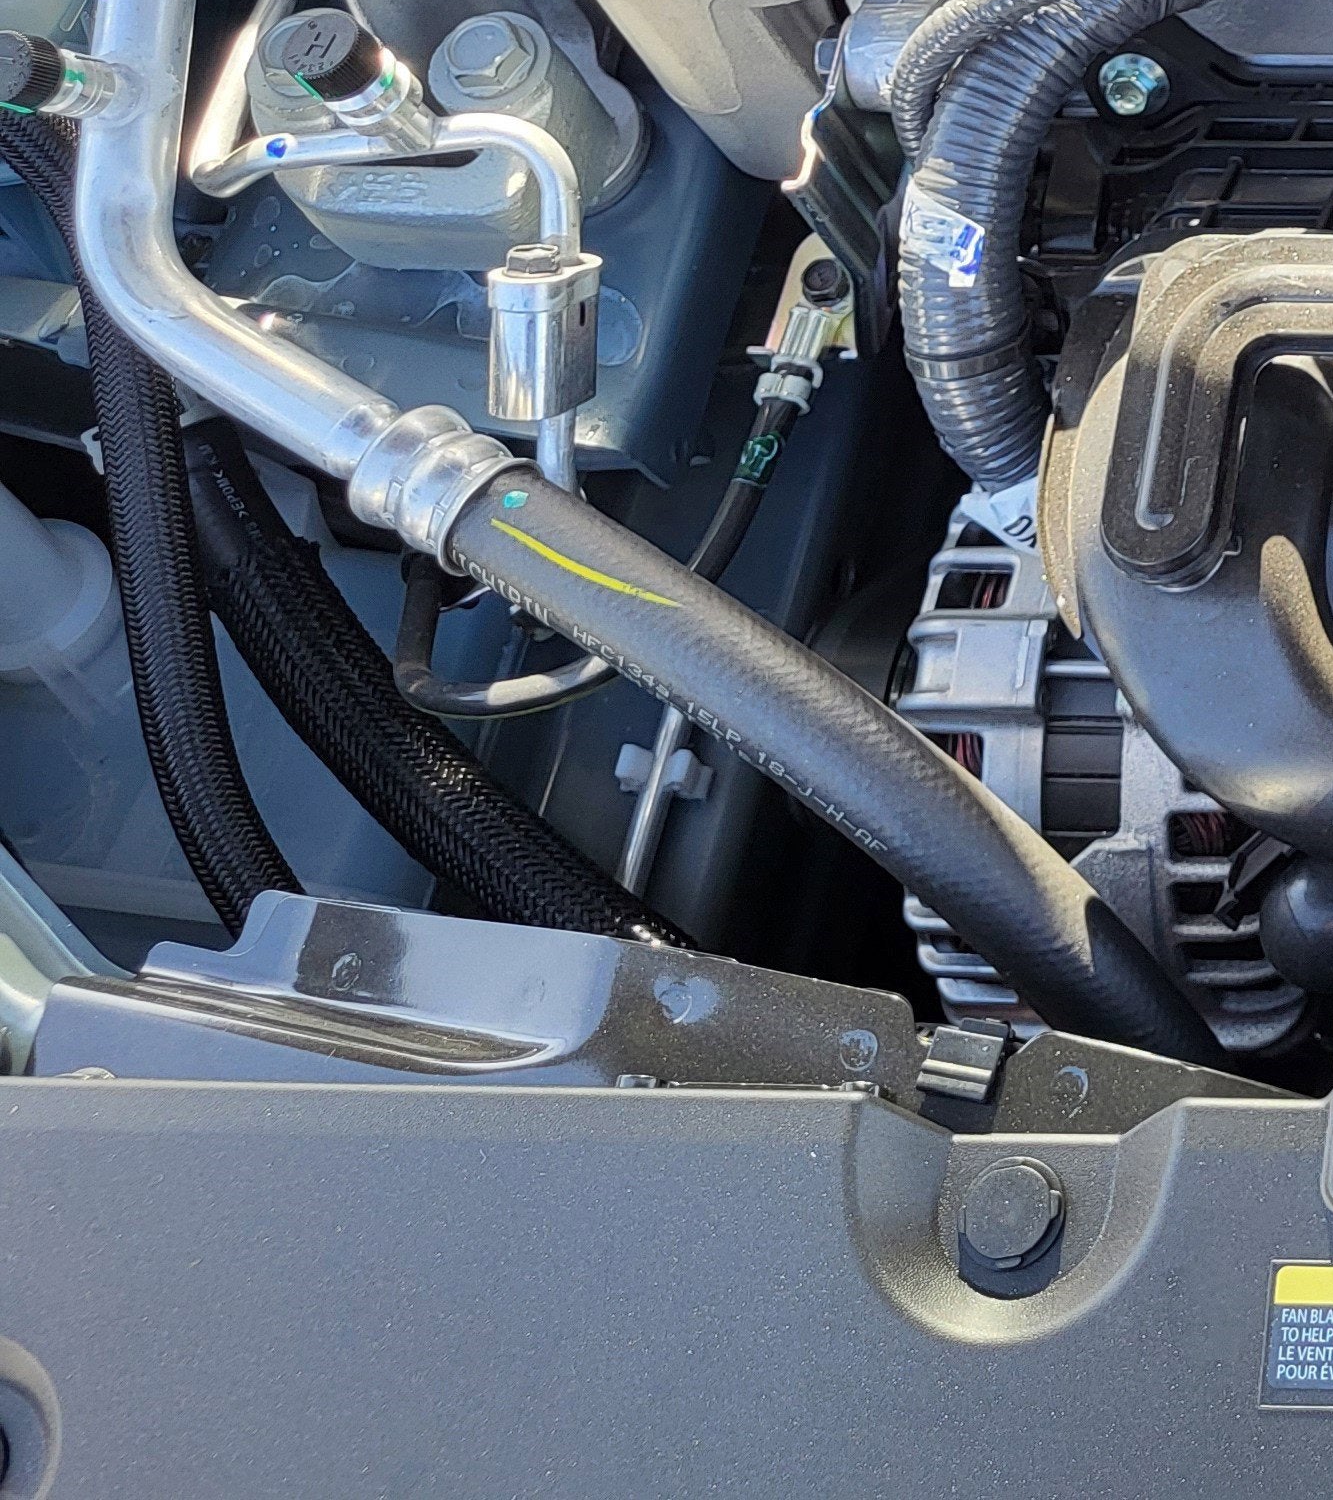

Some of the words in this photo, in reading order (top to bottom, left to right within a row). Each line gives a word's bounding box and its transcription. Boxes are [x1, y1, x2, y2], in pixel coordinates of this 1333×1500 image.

[1281, 1308, 1307, 1324] FAN
[1282, 1326, 1300, 1342] TO
[1278, 1346, 1296, 1361] LE
[1276, 1364, 1318, 1380] POUR
